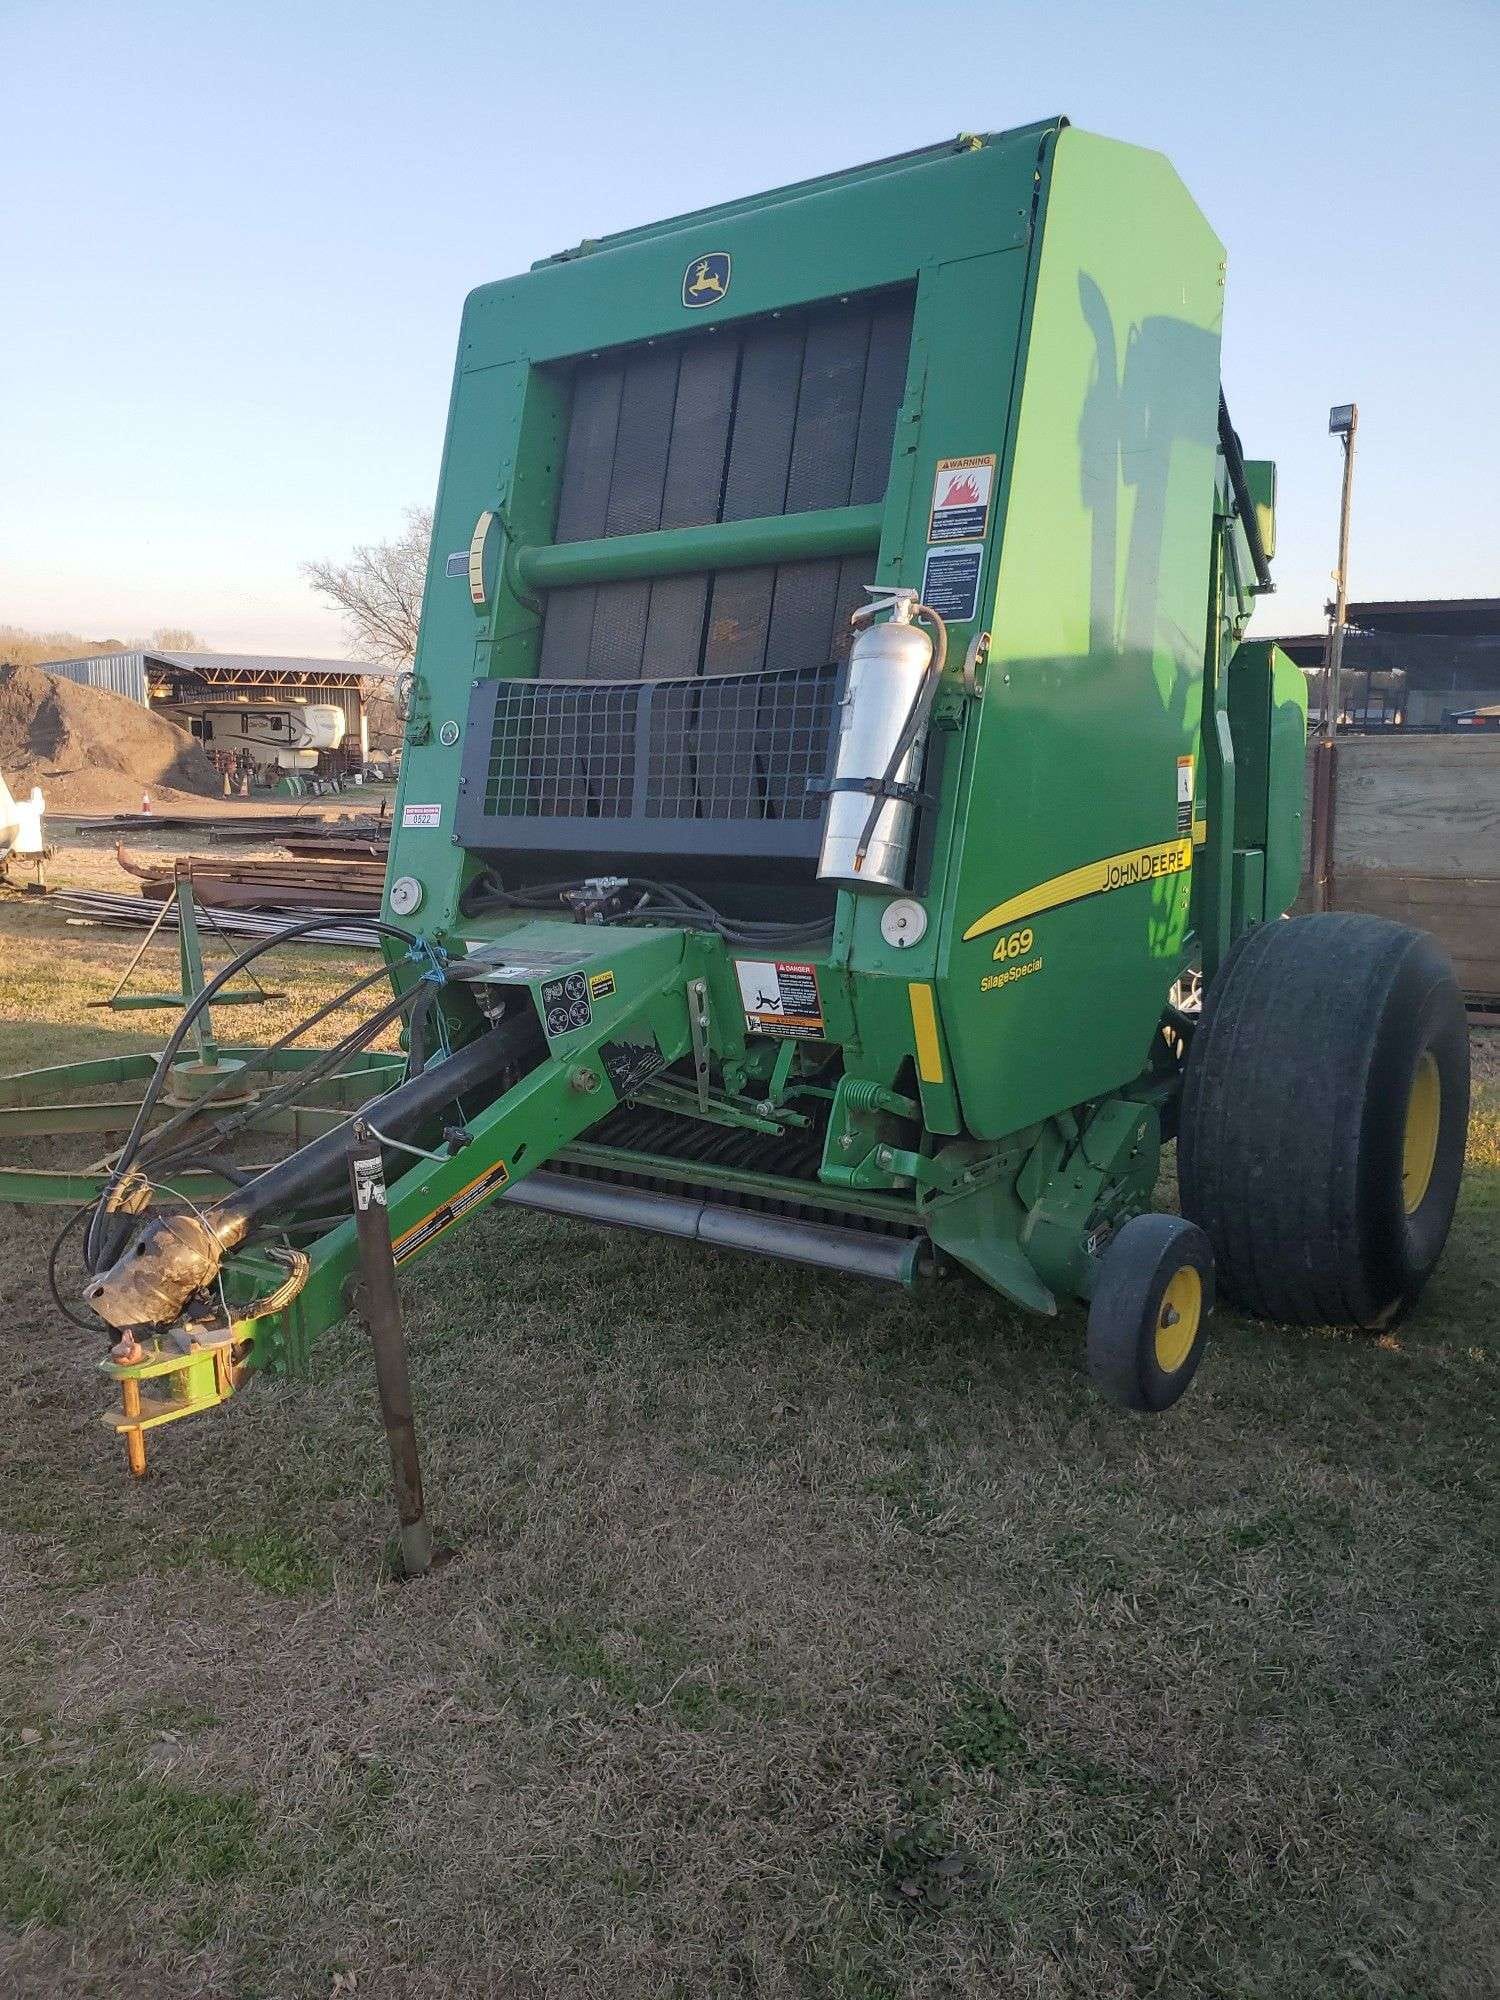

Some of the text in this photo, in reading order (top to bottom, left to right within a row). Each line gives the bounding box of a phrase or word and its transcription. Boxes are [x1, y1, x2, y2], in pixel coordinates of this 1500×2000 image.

[949, 456, 992, 469] WARNING
[1102, 850, 1185, 889] JOHN DEERE
[992, 928, 1034, 962] 469
[785, 965, 811, 973] DANGER
[980, 956, 1043, 993] SilageSpecial
